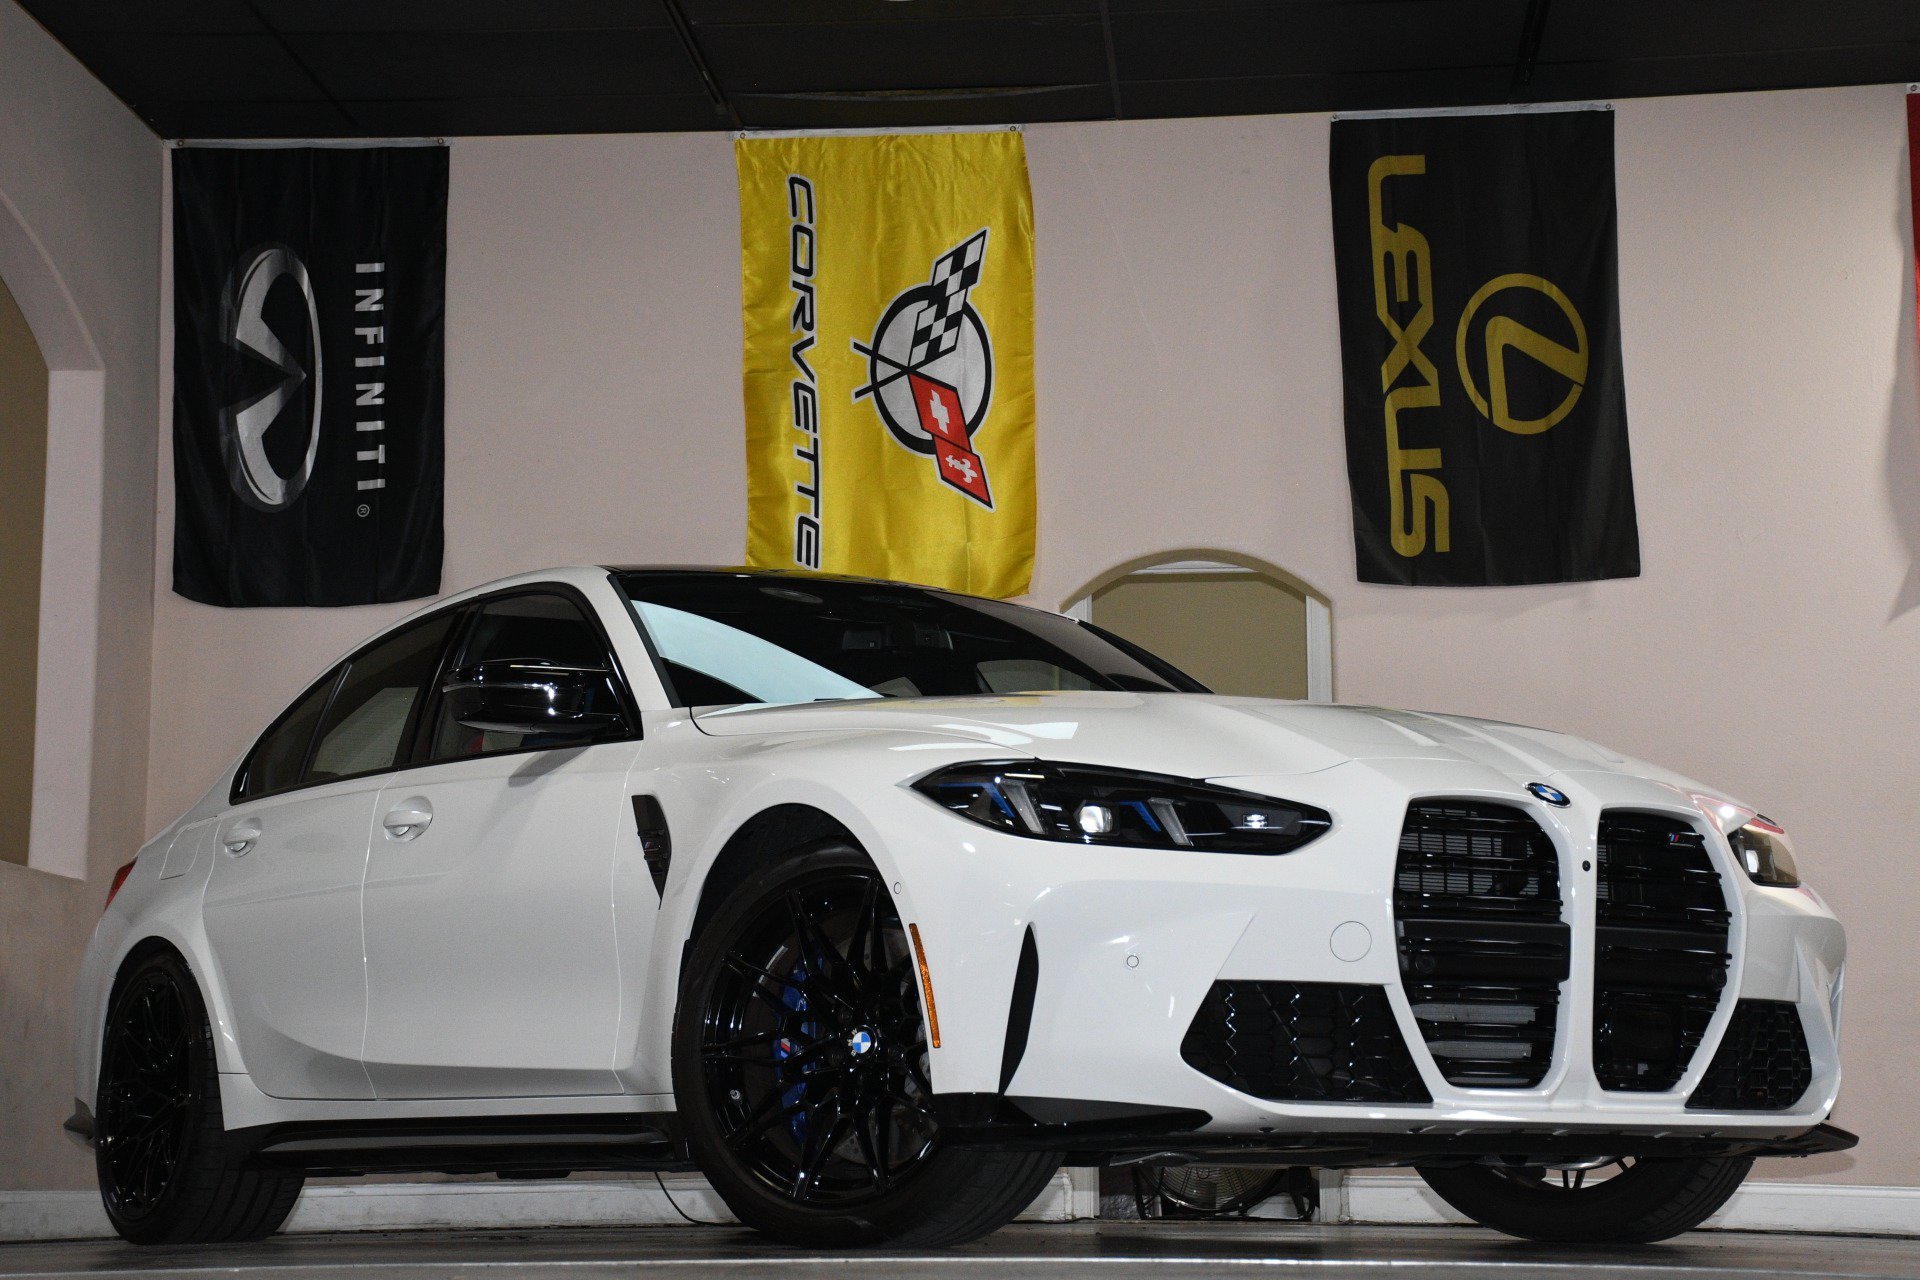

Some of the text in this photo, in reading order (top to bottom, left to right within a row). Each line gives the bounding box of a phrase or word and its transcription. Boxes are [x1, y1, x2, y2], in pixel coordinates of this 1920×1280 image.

[355, 262, 386, 491] INFINITI
[786, 174, 823, 571] CORVETTE
[1368, 155, 1450, 557] LEXUS
